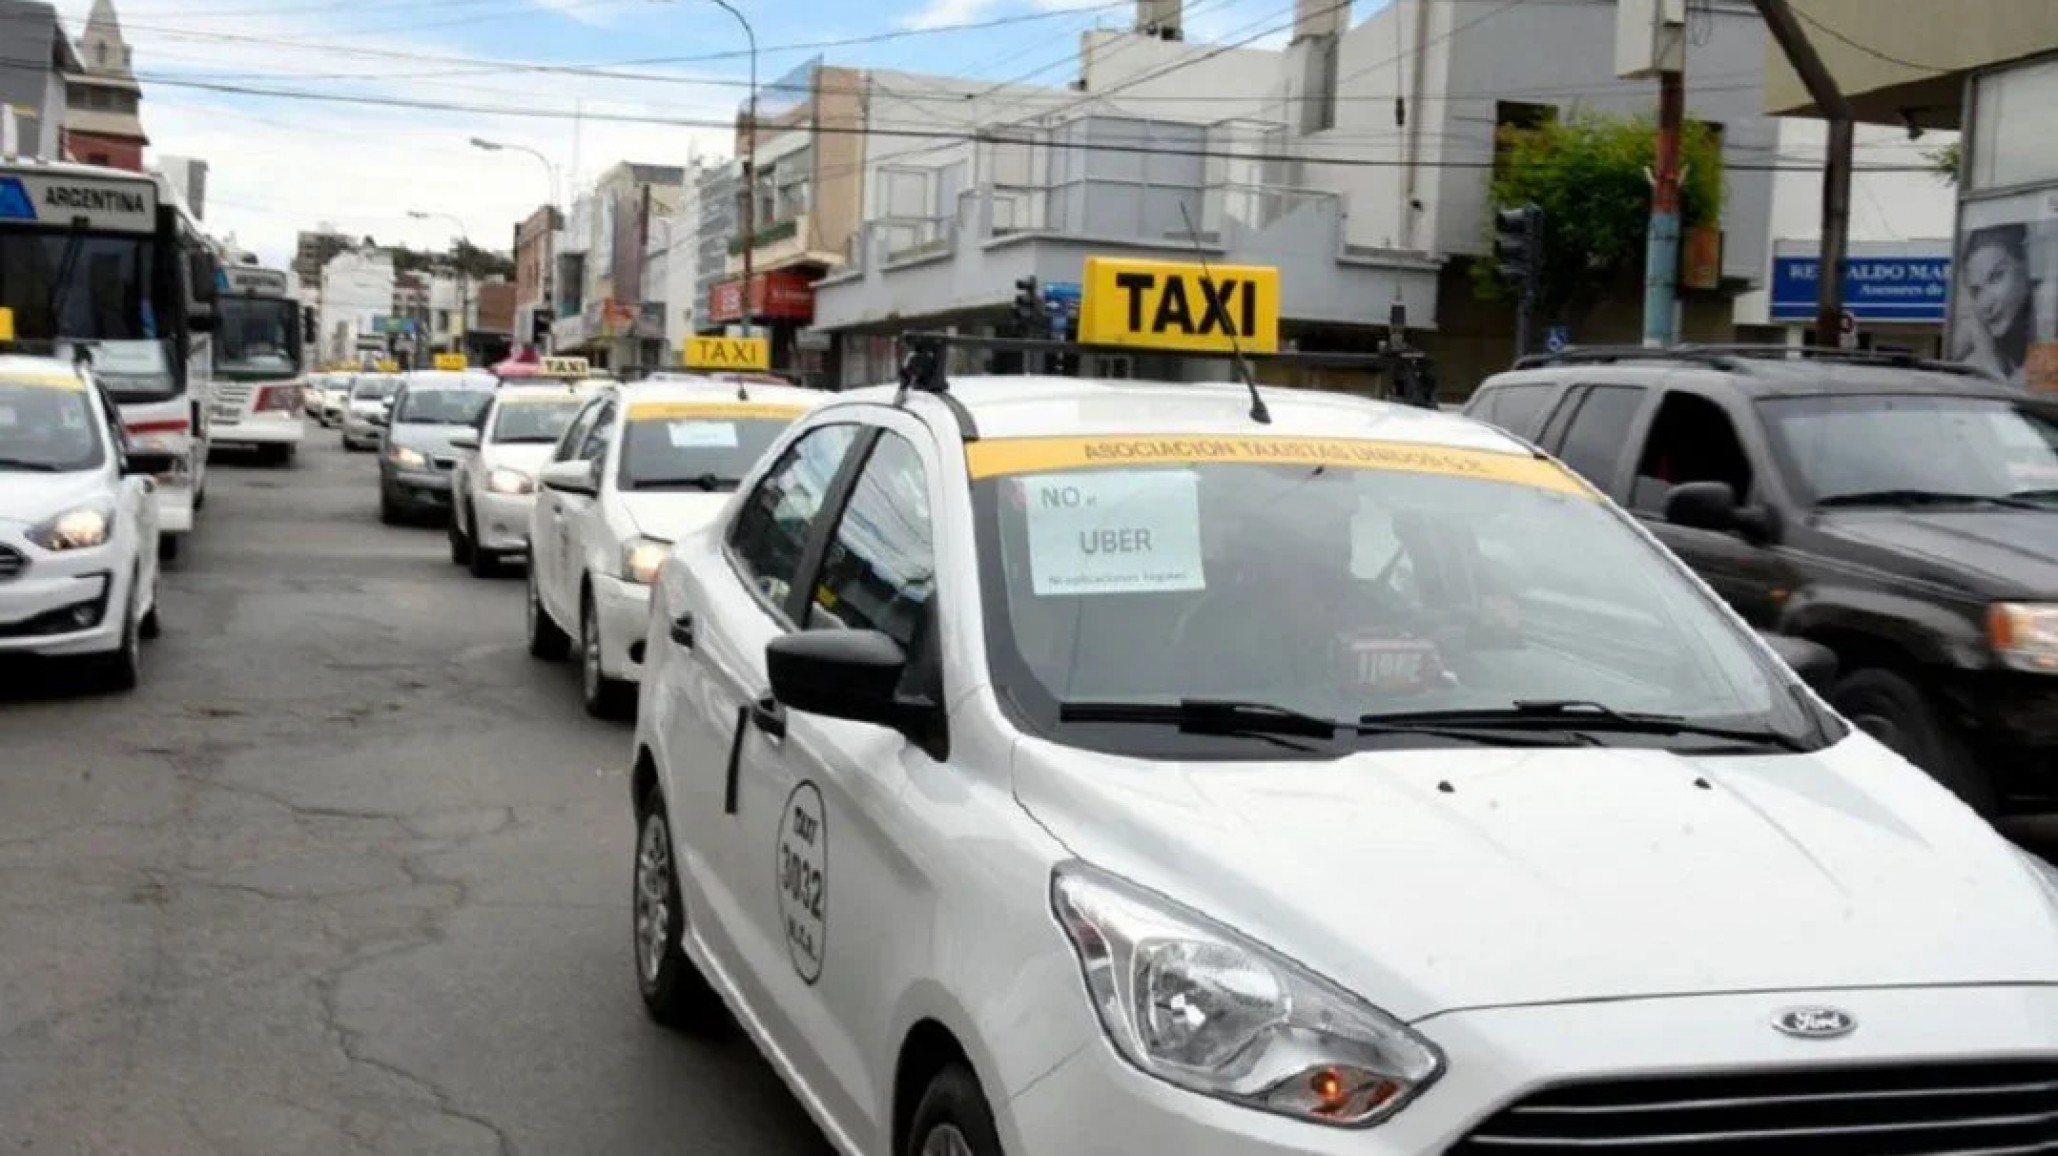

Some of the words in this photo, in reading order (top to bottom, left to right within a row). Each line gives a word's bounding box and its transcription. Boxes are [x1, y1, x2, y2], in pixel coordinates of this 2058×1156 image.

[45, 186, 146, 214] ARGENTINA
[1789, 263, 1905, 282] REALDO
[1115, 272, 1257, 338] TAXI
[696, 340, 758, 364] TAXI
[545, 359, 587, 374] TAXI
[1084, 441, 1237, 460] ASOCIACION
[1041, 486, 1081, 508] NO
[1079, 528, 1153, 555] UBER
[793, 806, 818, 846] TAXI
[782, 843, 822, 921] 3032
[1793, 1009, 1839, 1031] Ford
